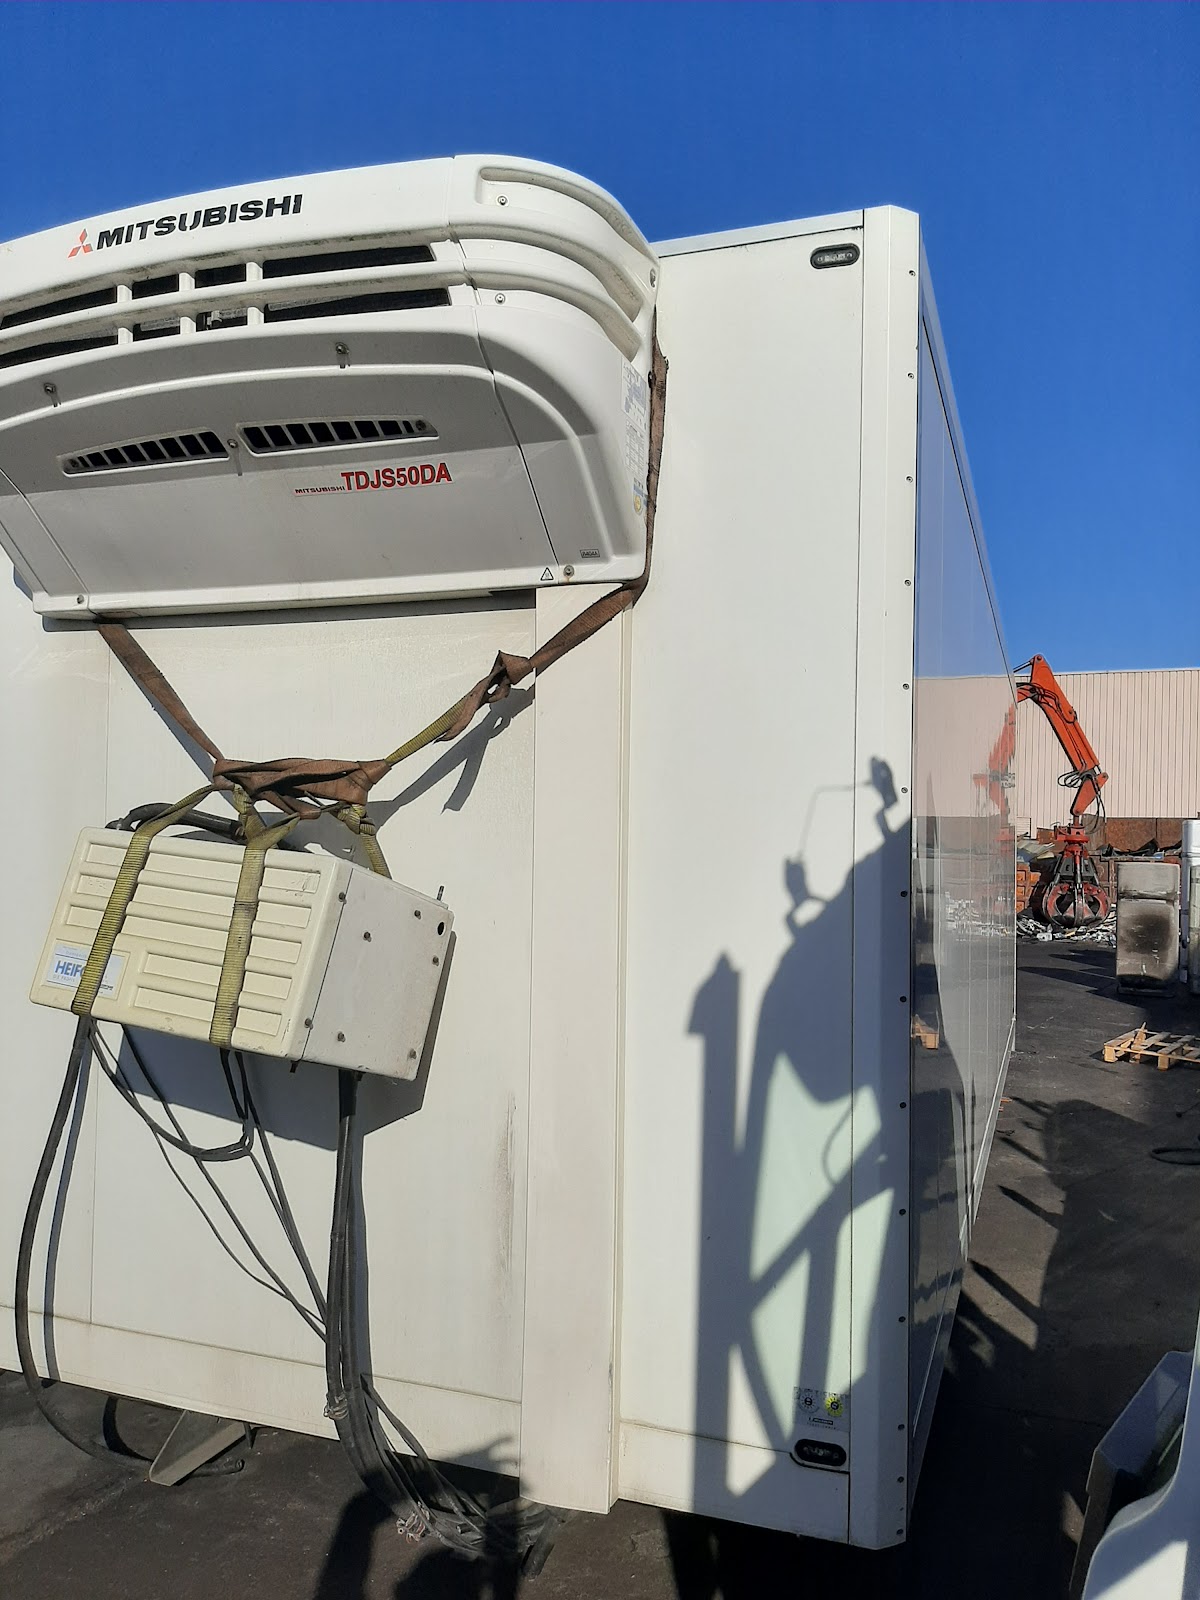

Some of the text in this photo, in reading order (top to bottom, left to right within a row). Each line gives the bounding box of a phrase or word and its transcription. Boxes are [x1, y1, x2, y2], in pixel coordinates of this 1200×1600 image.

[97, 194, 303, 250] MITSUBISHI
[294, 462, 453, 494] MITSUBISHI TDJS50DA
